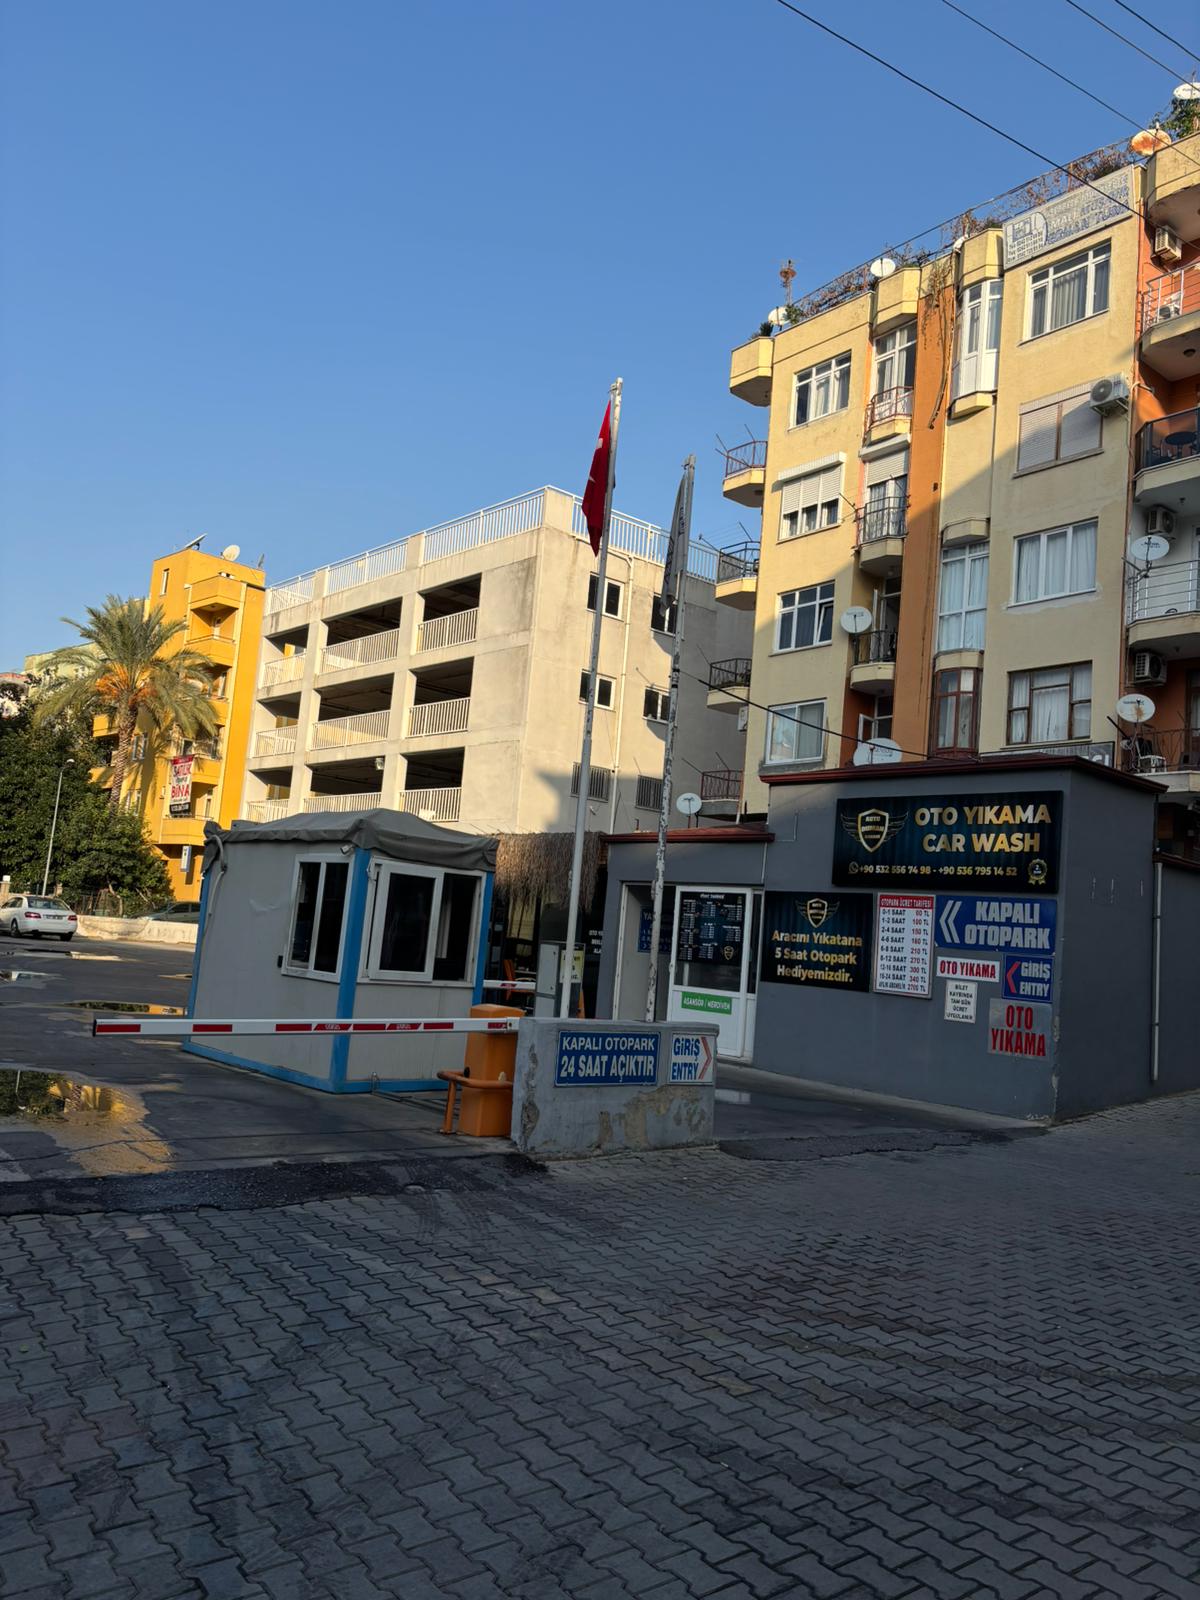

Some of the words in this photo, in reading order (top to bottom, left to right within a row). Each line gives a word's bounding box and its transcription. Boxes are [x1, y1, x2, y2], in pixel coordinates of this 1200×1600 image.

[172, 784, 189, 799] BİNA
[915, 808, 957, 826] OTO
[963, 805, 1052, 825] YIKAMA
[923, 833, 965, 853] CAR
[972, 832, 1040, 853] WASH
[860, 866, 874, 874] +90
[876, 866, 889, 874] 532
[891, 866, 906, 874] 556
[907, 866, 918, 874] 74
[938, 866, 954, 875] +90
[957, 867, 972, 875] 536
[975, 867, 991, 875] 795
[994, 867, 1004, 876] 14
[1006, 868, 1018, 876] 52
[881, 898, 899, 906] OTOPARK
[976, 901, 1040, 924] KAPALI
[772, 930, 810, 942] Aracını
[812, 932, 862, 946] Yıkatana
[964, 924, 1050, 949] OTOPARK
[775, 947, 782, 958] 5
[784, 948, 807, 960] Saat
[810, 950, 857, 966] Otopark
[777, 964, 853, 983] Hediyemizdir.
[940, 960, 958, 974] OTO
[960, 961, 996, 978] YIKAMA
[1020, 960, 1051, 981] GİRİŞ
[1019, 981, 1050, 997] ENTRY
[1006, 1005, 1033, 1030] OTO
[562, 1036, 602, 1050] KAPALI
[605, 1037, 655, 1050] OTOPARK
[991, 1028, 1046, 1057] YIKAMA
[560, 1055, 575, 1077] 24
[578, 1055, 608, 1077] SAAT
[610, 1055, 654, 1082] AÇIKTIR
[672, 1062, 699, 1080] ENTRY
